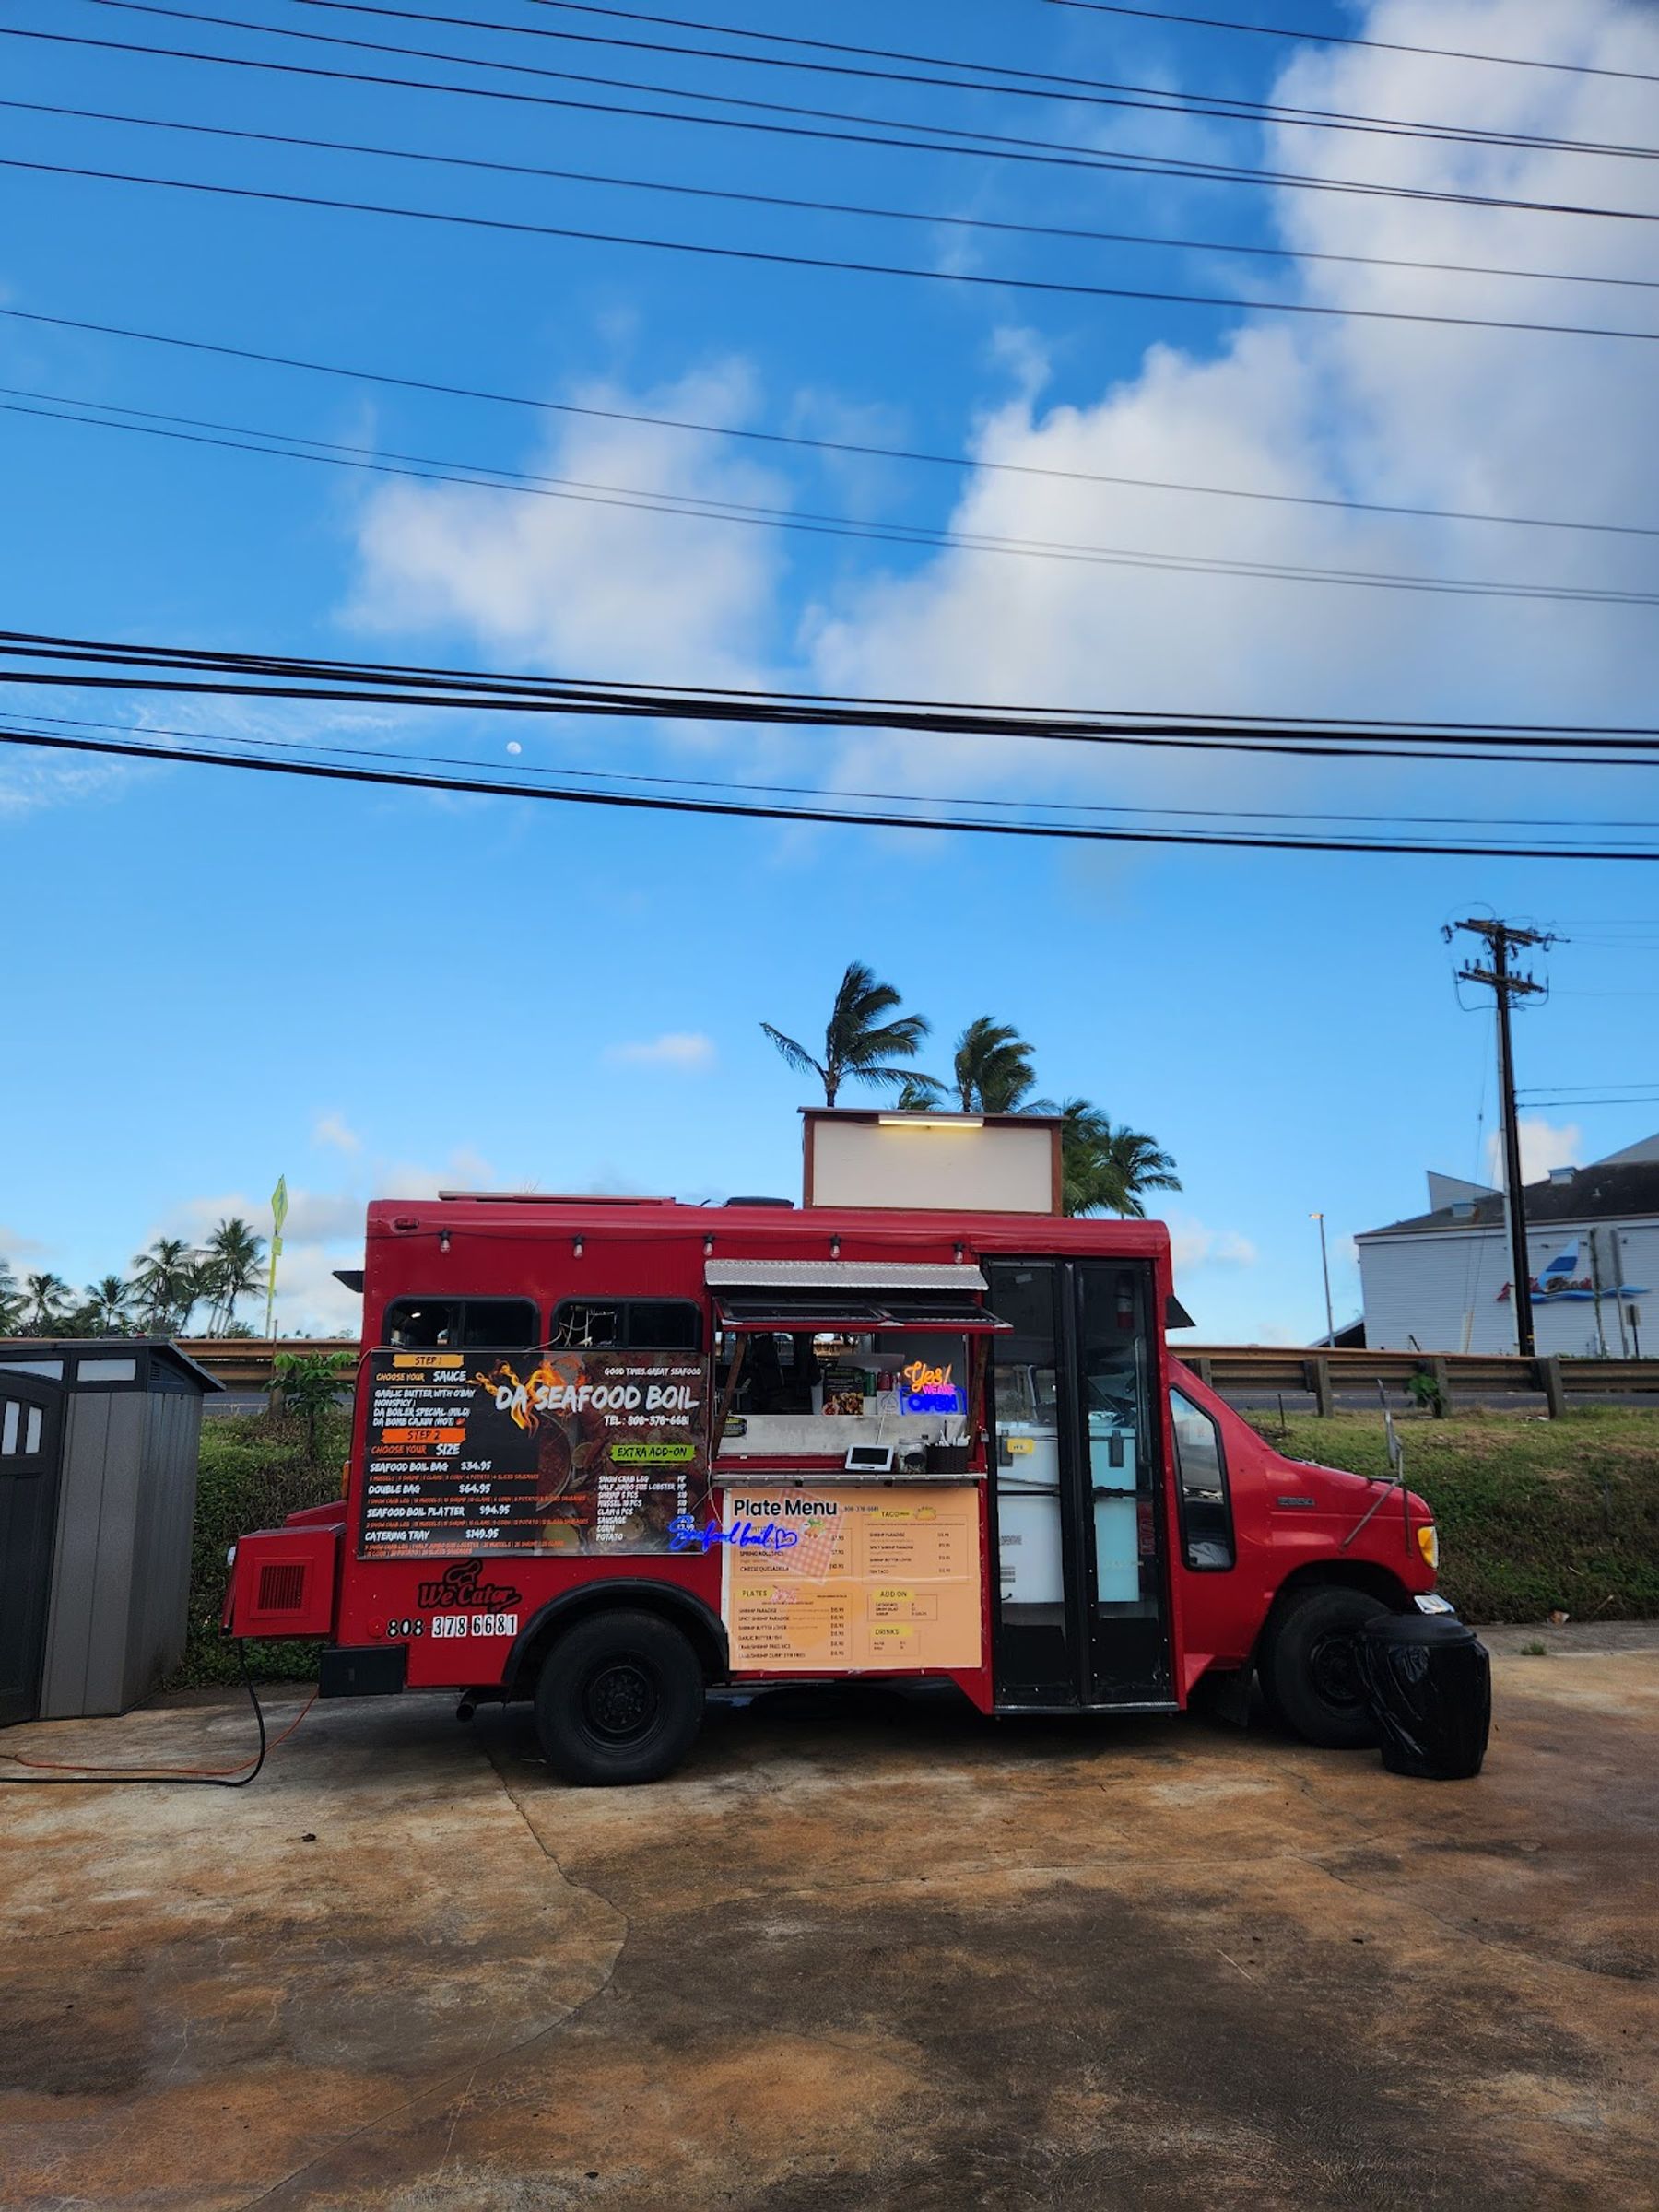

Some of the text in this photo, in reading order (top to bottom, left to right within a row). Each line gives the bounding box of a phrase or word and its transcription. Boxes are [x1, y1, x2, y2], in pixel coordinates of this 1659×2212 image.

[415, 1357, 436, 1365] STEP
[376, 1371, 466, 1382] CHOOSE YOUR SAUCE
[605, 1368, 625, 1376] GOOD
[671, 1368, 701, 1376] SEAFOOD
[904, 1361, 952, 1393] Yes!
[374, 1390, 402, 1398] GARLIC
[404, 1390, 432, 1399] BUTTER
[433, 1390, 452, 1398] WITH
[495, 1385, 700, 1413] DA SEAFOOD BOIL
[909, 1394, 958, 1412] OPEN
[374, 1408, 385, 1417] DA
[387, 1408, 414, 1417] BOILER
[415, 1408, 446, 1417] SPECIAL
[372, 1418, 384, 1427] DA
[408, 1418, 433, 1426] CAJUN
[629, 1416, 689, 1426] 808-378-6681
[407, 1430, 441, 1441] STEP 2
[371, 1443, 461, 1455] CHOOSE YOUR SIZE
[618, 1447, 687, 1458] EXTRA ADD-ON
[370, 1461, 492, 1473] SEAFOOD BOIL BAG $34.95
[369, 1484, 492, 1495] DOUBLE BAG $64.95
[627, 1491, 639, 1500] PCS
[367, 1504, 511, 1519] SEAFOOD BOIL PLATTER $94.95
[597, 1508, 615, 1516] CLAM
[734, 1499, 782, 1517] Plate
[785, 1499, 838, 1516] Menu
[597, 1524, 615, 1533] CORN
[365, 1528, 500, 1542] CATERING TRAY $149.95
[596, 1534, 623, 1542] POTATO
[419, 1583, 454, 1607] We
